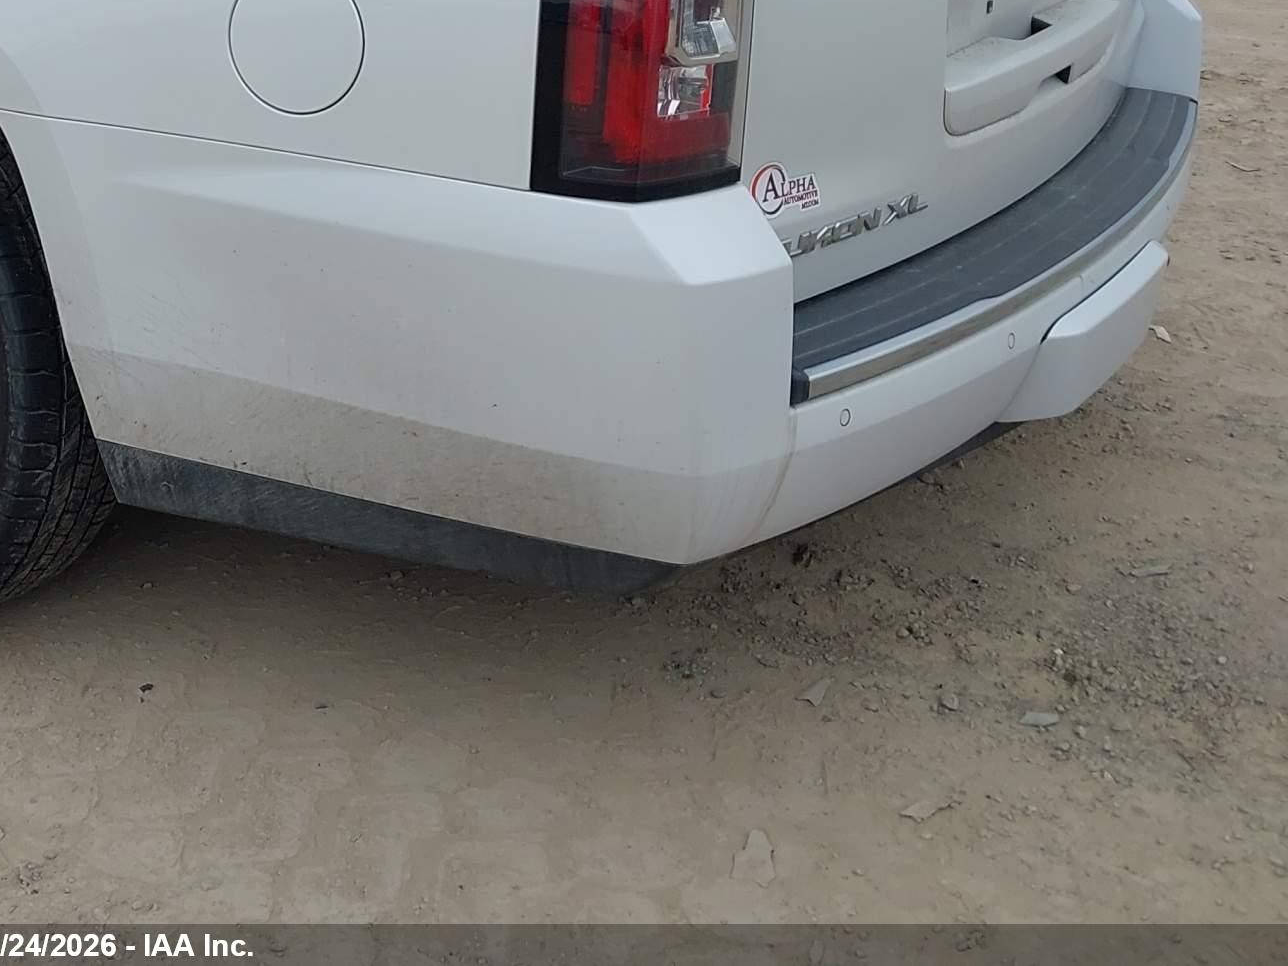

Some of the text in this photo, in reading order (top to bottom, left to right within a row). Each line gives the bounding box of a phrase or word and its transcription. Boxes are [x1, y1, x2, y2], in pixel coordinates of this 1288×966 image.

[762, 171, 817, 202] ALPHA
[781, 193, 928, 257] UKON XL
